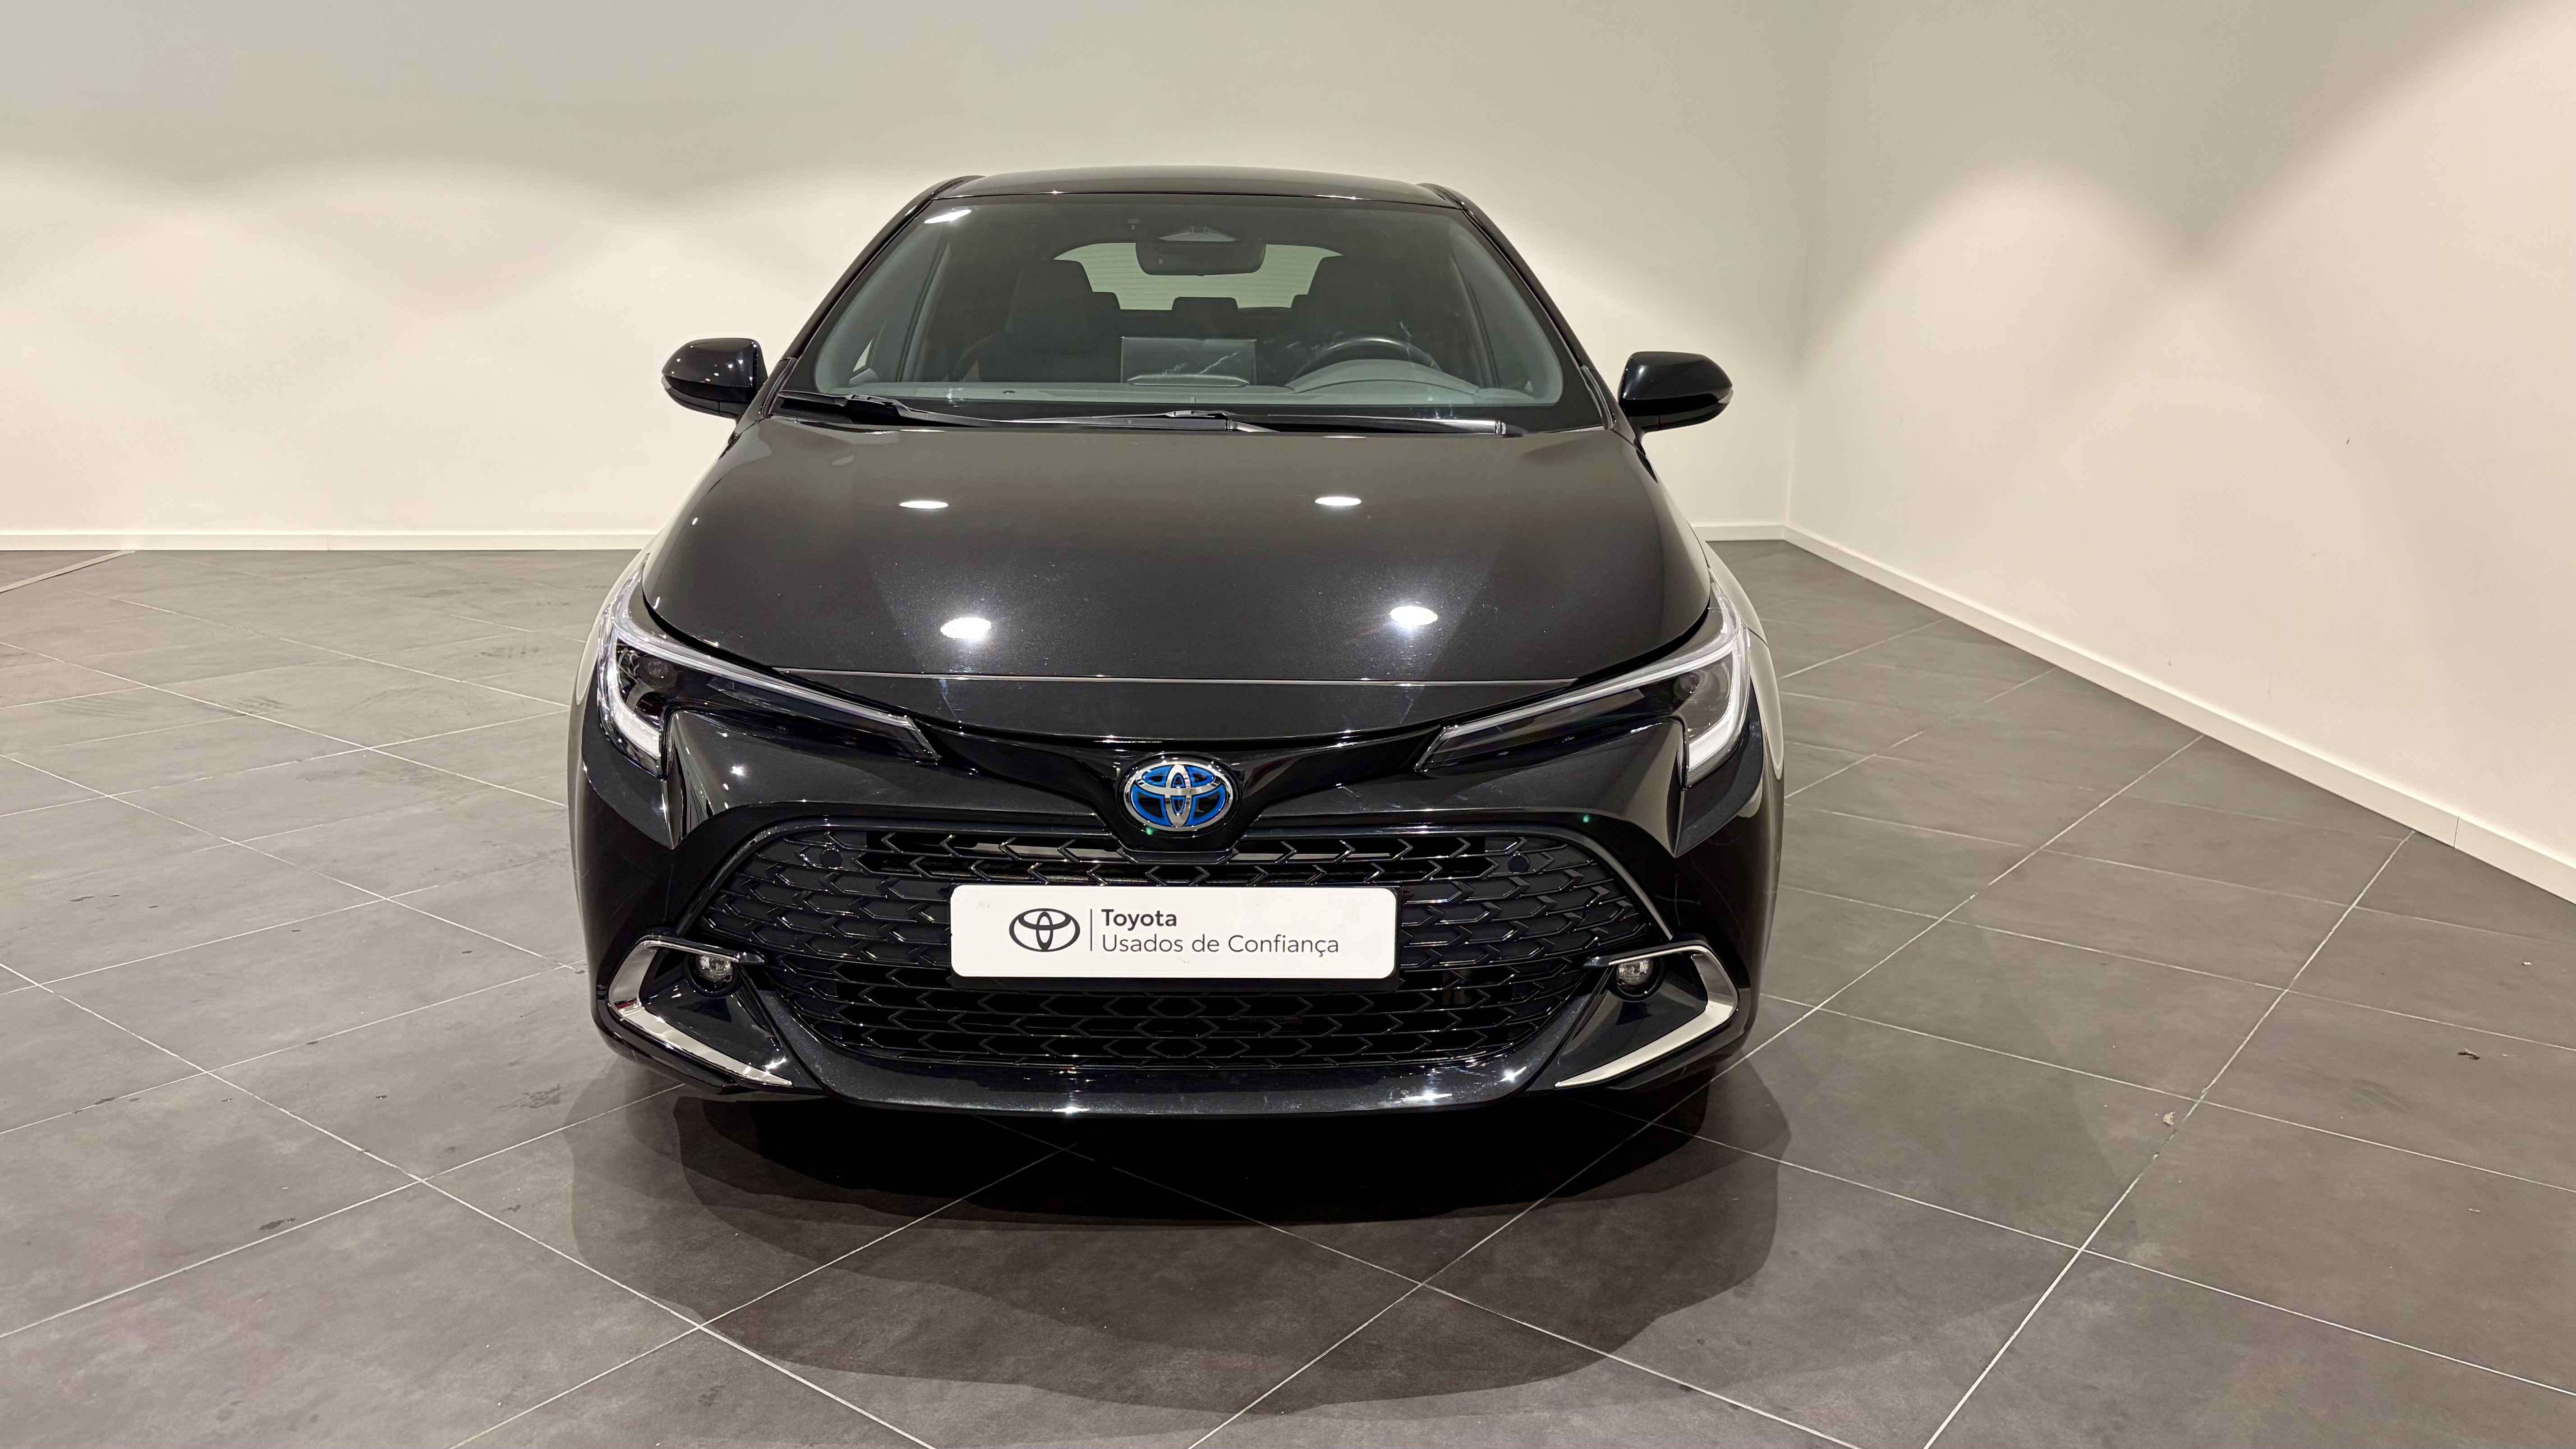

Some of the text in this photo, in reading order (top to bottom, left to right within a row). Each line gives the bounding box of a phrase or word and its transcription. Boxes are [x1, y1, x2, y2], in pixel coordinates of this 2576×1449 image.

[1101, 909, 1177, 931] Toyota
[1102, 934, 1339, 957] Usados de Confiança
